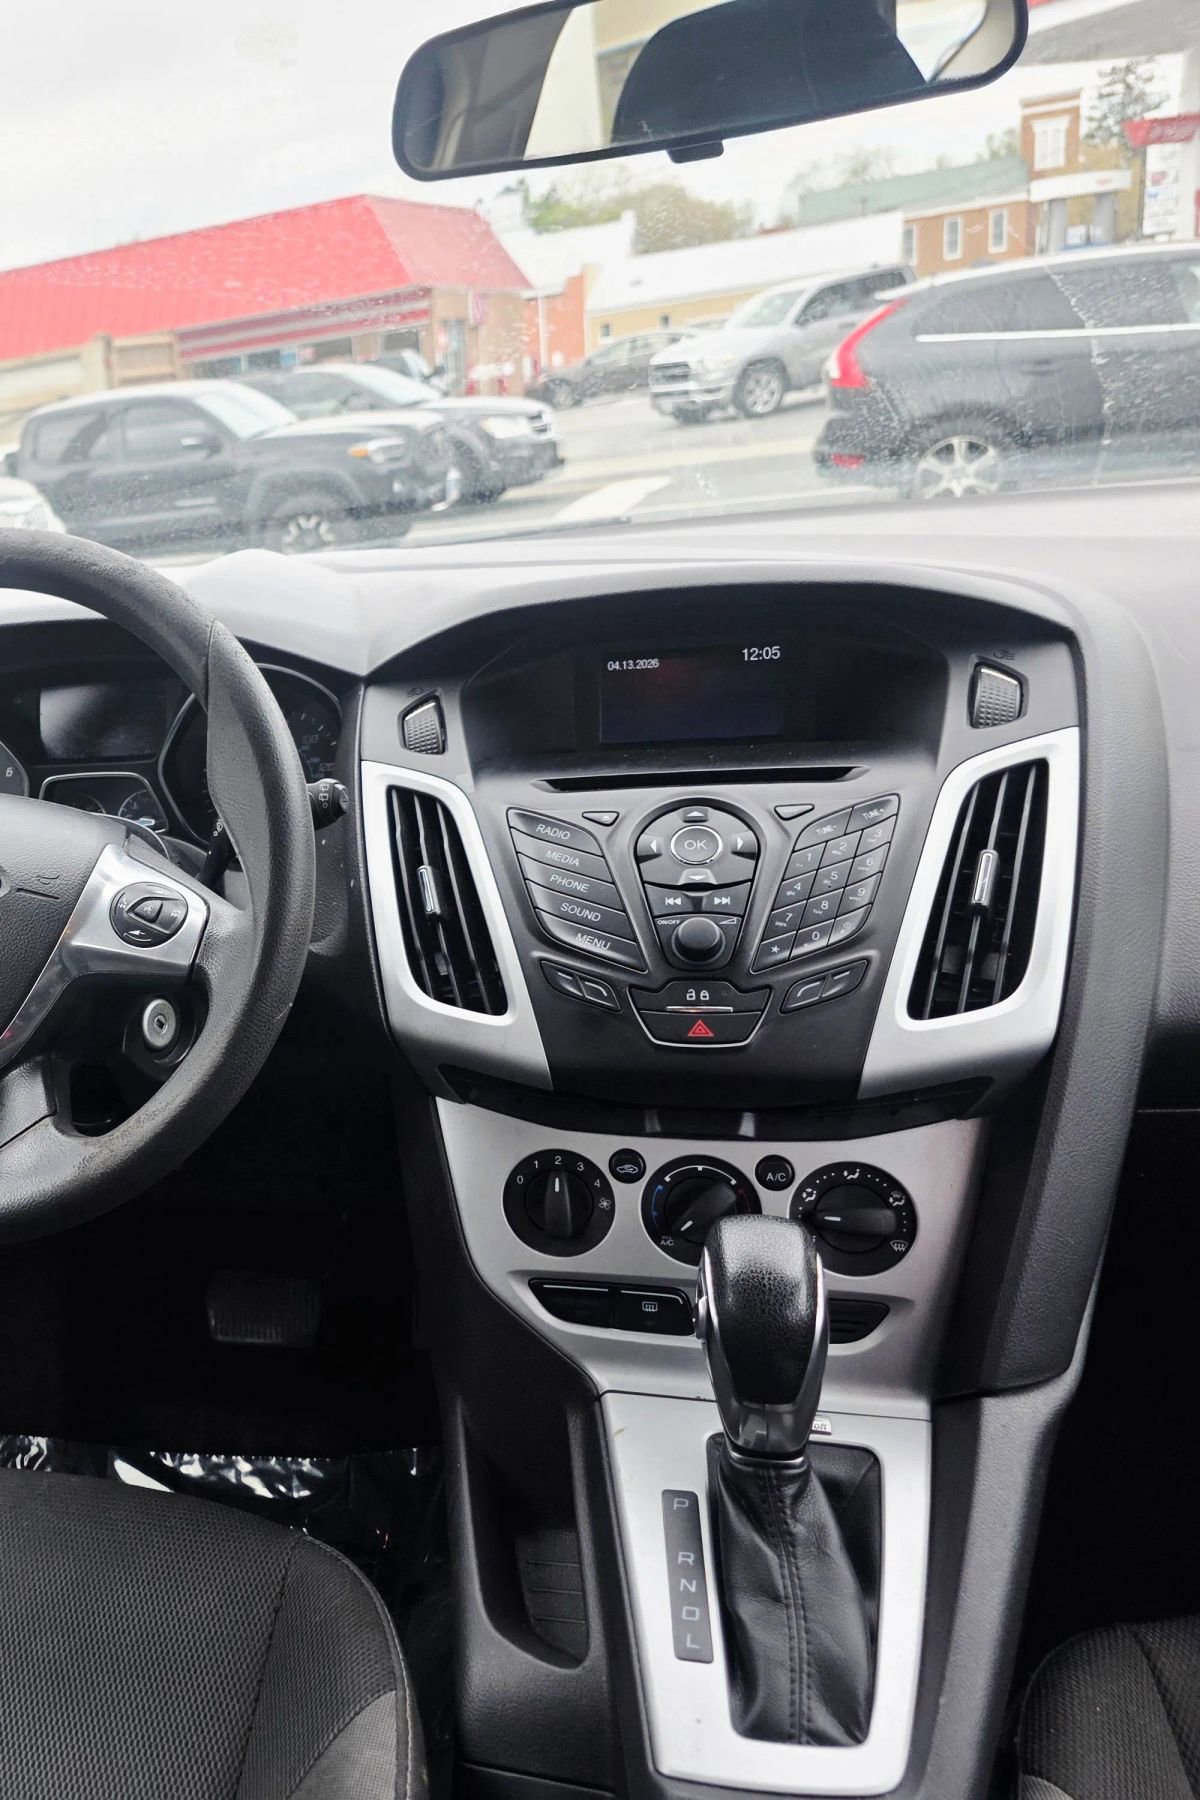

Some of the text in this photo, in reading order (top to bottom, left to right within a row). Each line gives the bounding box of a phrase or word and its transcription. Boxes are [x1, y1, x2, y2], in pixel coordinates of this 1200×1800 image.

[742, 646, 781, 661] 12:05
[607, 658, 660, 671] 04.13.2026
[5, 766, 14, 777] 6
[535, 823, 571, 840] RADIO
[873, 829, 882, 838] 3
[684, 839, 707, 850] OK
[839, 842, 848, 851] 2
[544, 850, 580, 867] MEDIA
[806, 853, 812, 862] 1
[865, 857, 874, 866] 6
[830, 871, 839, 880] 5
[550, 874, 590, 893] PHONE
[793, 882, 802, 892] 4
[857, 887, 866, 897] 9
[820, 900, 829, 910] 8
[560, 902, 601, 922] SOUND
[785, 912, 793, 922] 7
[657, 918, 681, 926] ON/OFF
[575, 932, 611, 950] MENU
[811, 931, 820, 941] 0
[533, 1160, 539, 1169] 1
[554, 1155, 562, 1165] 2
[576, 1162, 585, 1171] 3
[516, 1175, 524, 1185] 0
[766, 1172, 787, 1182] A/C
[593, 1179, 601, 1188] 4
[673, 1497, 689, 1511] P
[677, 1551, 695, 1566] R
[680, 1578, 697, 1593] N
[681, 1605, 700, 1621] D
[686, 1633, 700, 1649] L
